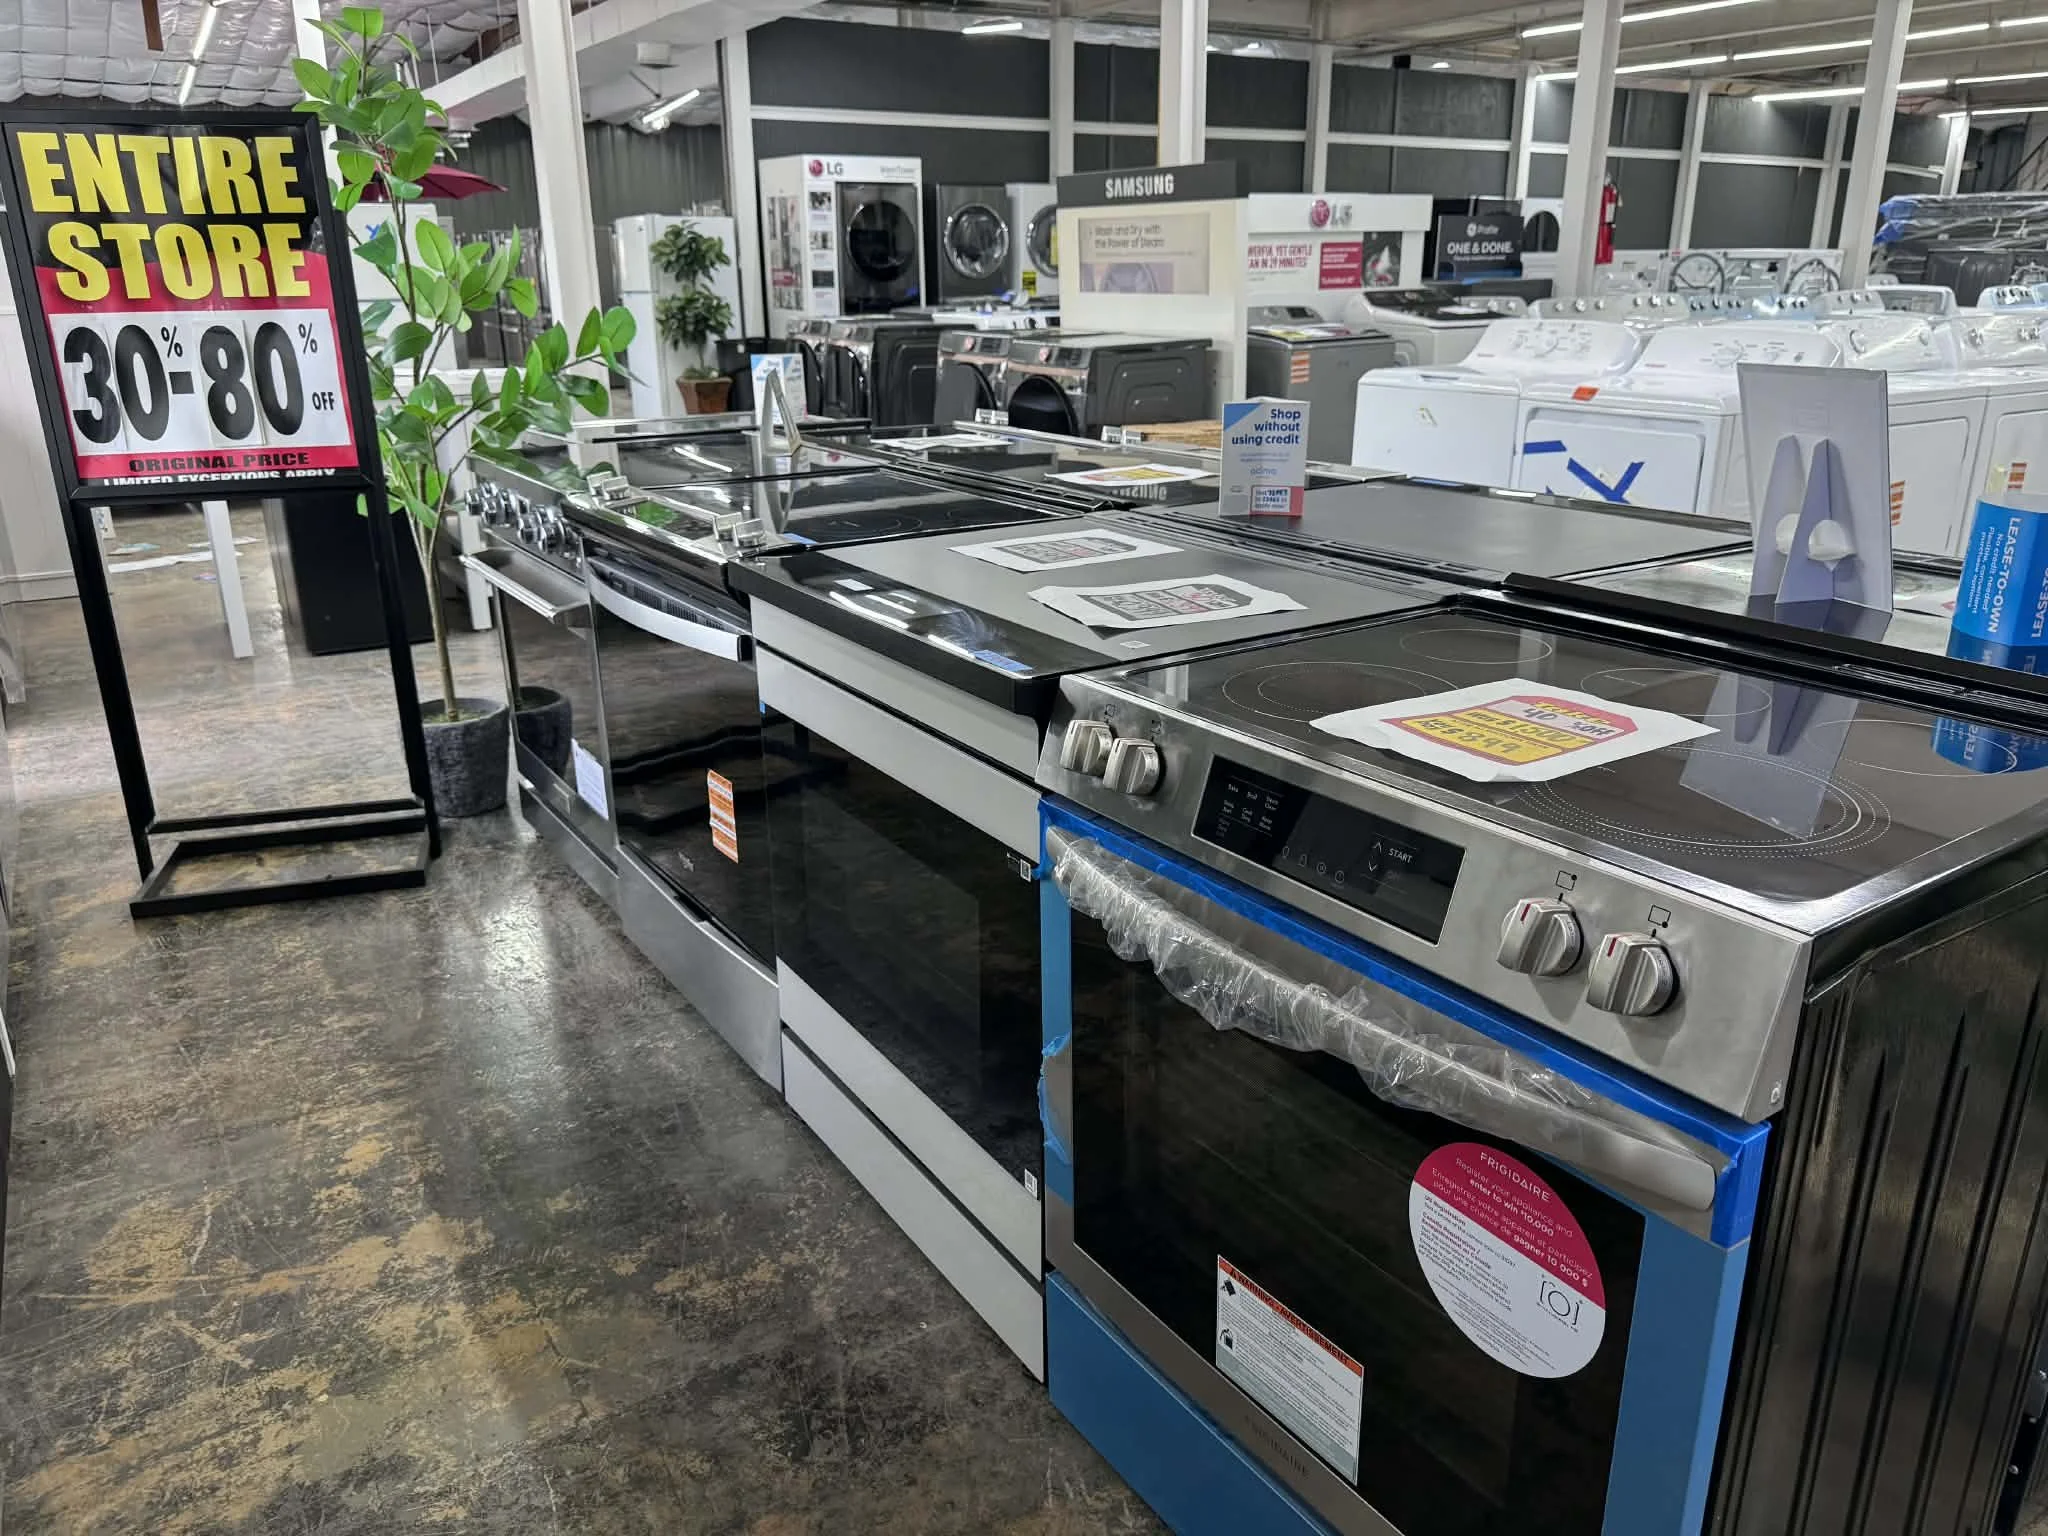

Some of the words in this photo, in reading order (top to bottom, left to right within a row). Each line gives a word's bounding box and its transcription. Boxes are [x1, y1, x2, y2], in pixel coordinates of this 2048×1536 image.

[16, 132, 306, 215] ENTIRE
[827, 162, 844, 175] LG
[1105, 174, 1174, 199] SAMSUNG
[1331, 205, 1352, 226] LG
[1447, 242, 1471, 255] ONE
[1472, 242, 1480, 254] &
[48, 222, 310, 301] STORE
[312, 391, 335, 411] OFF
[1271, 409, 1301, 420] Shop
[1254, 421, 1300, 432] without
[1232, 434, 1262, 446] using
[1265, 433, 1299, 445] credit
[129, 455, 238, 473] ORIGINAL
[243, 451, 310, 468] PRICE
[1996, 534, 2004, 546] No
[1989, 548, 2000, 574] credit
[1987, 517, 2022, 633] LEASE-TO-OWN
[1523, 706, 1557, 721] 40
[1388, 847, 1414, 864] START
[1480, 1152, 1551, 1202] FRIGIDAIRE
[1469, 1178, 1492, 1197] enter
[1492, 1192, 1503, 1203] to
[1504, 1200, 1519, 1216] win
[1513, 1234, 1545, 1259] gagner
